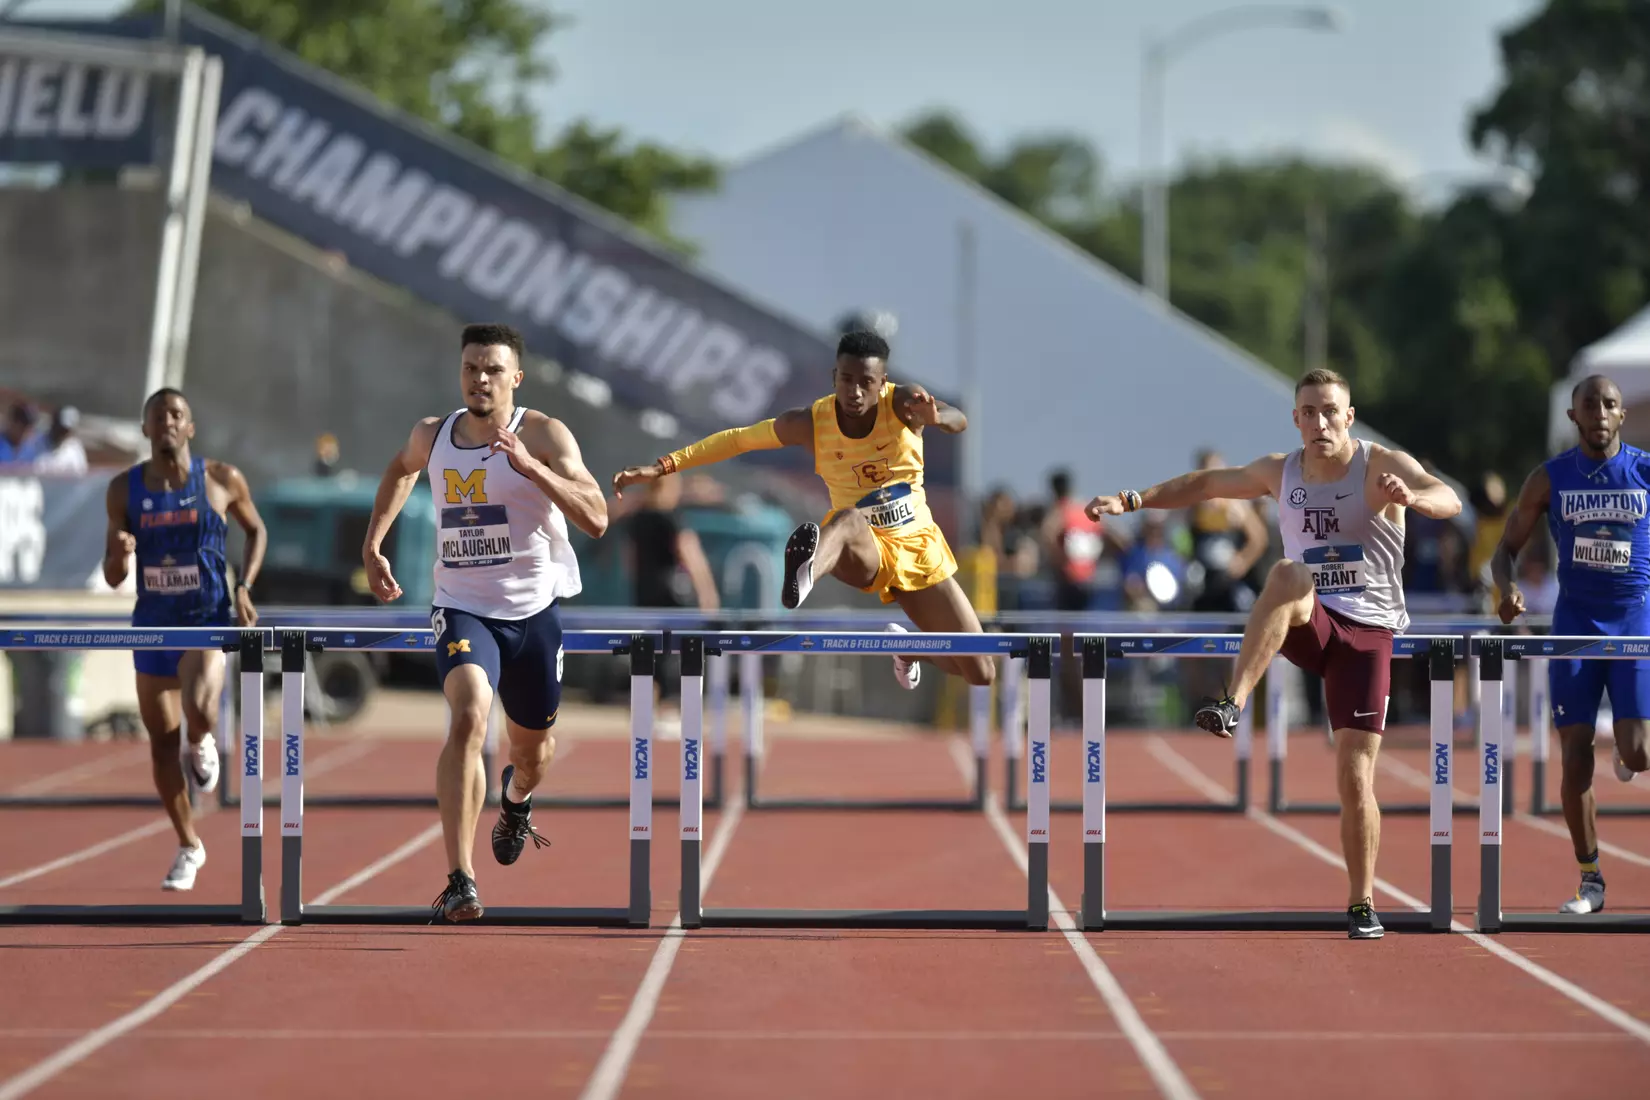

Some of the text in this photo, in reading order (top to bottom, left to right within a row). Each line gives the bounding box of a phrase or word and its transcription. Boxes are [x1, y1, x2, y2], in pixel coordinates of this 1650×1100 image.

[214, 88, 793, 419] CHAMPIONSHIPS
[443, 468, 489, 504] M
[1565, 493, 1643, 515] HAMPTON
[1579, 512, 1629, 520] PIRATES
[458, 528, 485, 538] TAYLOR
[442, 537, 511, 558] MCLAUGHLIN
[1575, 545, 1629, 564] WILLIAMS
[1321, 563, 1345, 571] ROBERT
[1312, 570, 1357, 587] GRANT
[34, 634, 62, 644] TRACK
[69, 634, 91, 644] FIELD
[93, 634, 164, 644] CHAMPIONSHIPS
[447, 639, 471, 656] M
[822, 639, 849, 649] TRACK
[857, 639, 880, 649] FIELD
[882, 639, 951, 649] CHAMPIONSHIPS
[1622, 644, 1649, 653] TRACK
[245, 734, 258, 776] NCAA
[286, 734, 299, 776] NCAA
[635, 737, 648, 780] NCAA
[685, 738, 698, 780] NCAA
[1032, 741, 1045, 783] NCAA
[1087, 741, 1100, 783] NCAA
[1435, 742, 1448, 785] NCAA
[1485, 742, 1498, 785] NCAA
